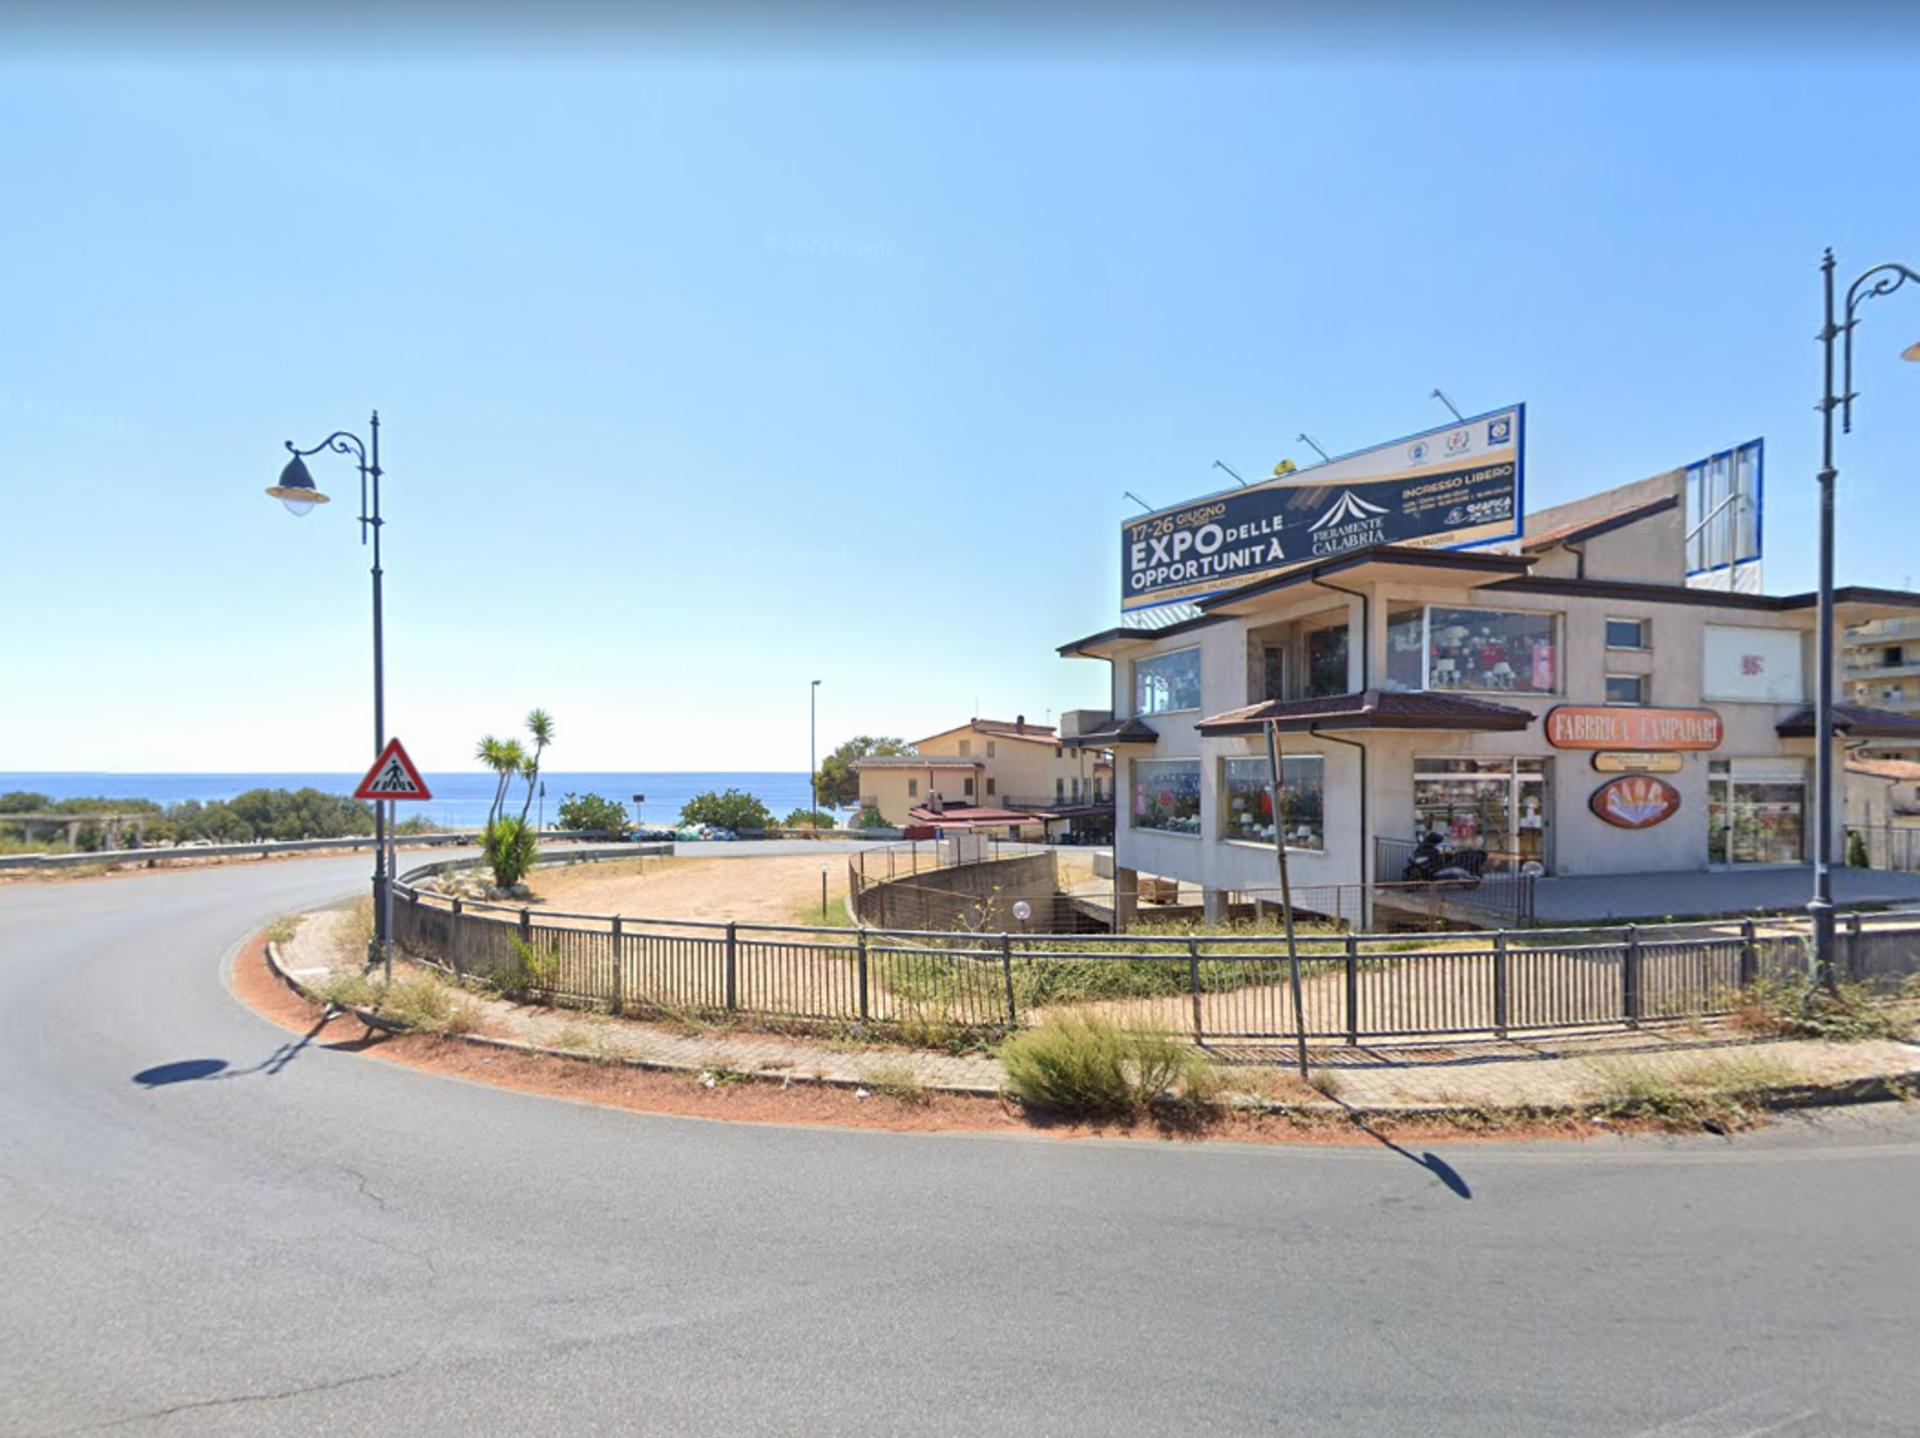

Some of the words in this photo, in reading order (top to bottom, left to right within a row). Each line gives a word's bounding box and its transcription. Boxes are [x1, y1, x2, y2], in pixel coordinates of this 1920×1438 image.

[1402, 477, 1462, 500] INGRESSO
[1465, 465, 1513, 485] LIBERO
[1131, 516, 1174, 542] 17-26
[1176, 502, 1226, 525] GIUGNO
[1312, 516, 1384, 543] FIERAMENTE
[1131, 523, 1224, 572] EXPO
[1226, 515, 1283, 543] DELLE
[1312, 530, 1385, 556] CALABRIA
[1131, 537, 1285, 589] OPPORTUNITÀ
[1555, 714, 1630, 741] FABBRICA
